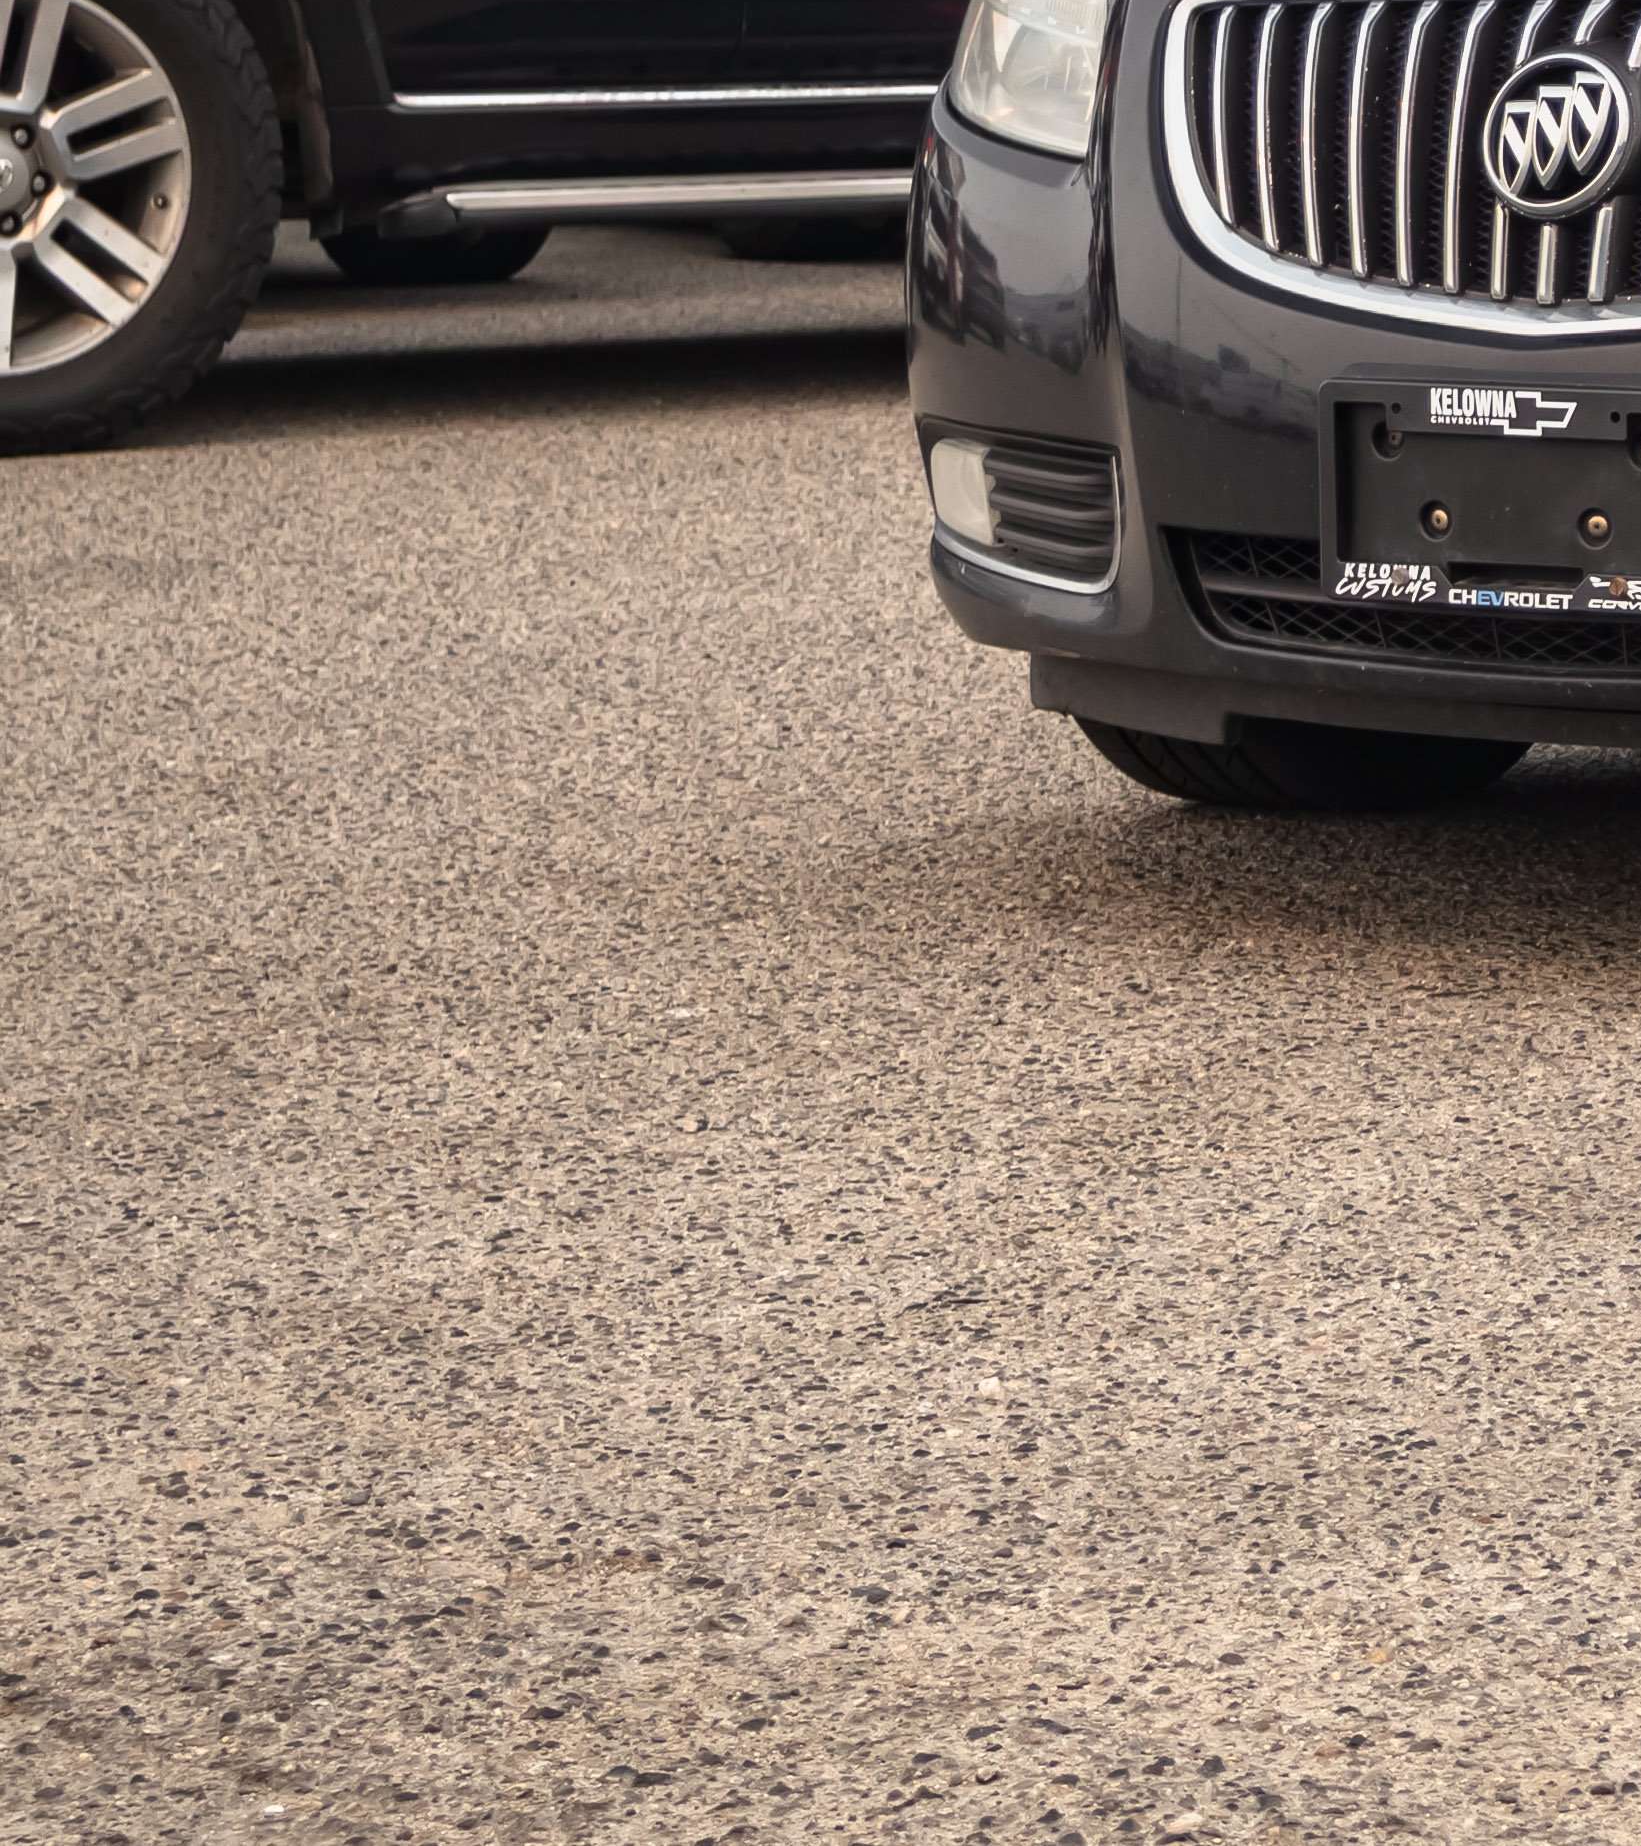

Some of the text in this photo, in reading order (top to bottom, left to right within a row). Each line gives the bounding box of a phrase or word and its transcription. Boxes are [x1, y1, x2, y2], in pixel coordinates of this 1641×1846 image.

[1430, 387, 1517, 418] KELOWNA
[1430, 415, 1492, 426] CHEVROLET
[1448, 588, 1573, 610] CHEVROLET
